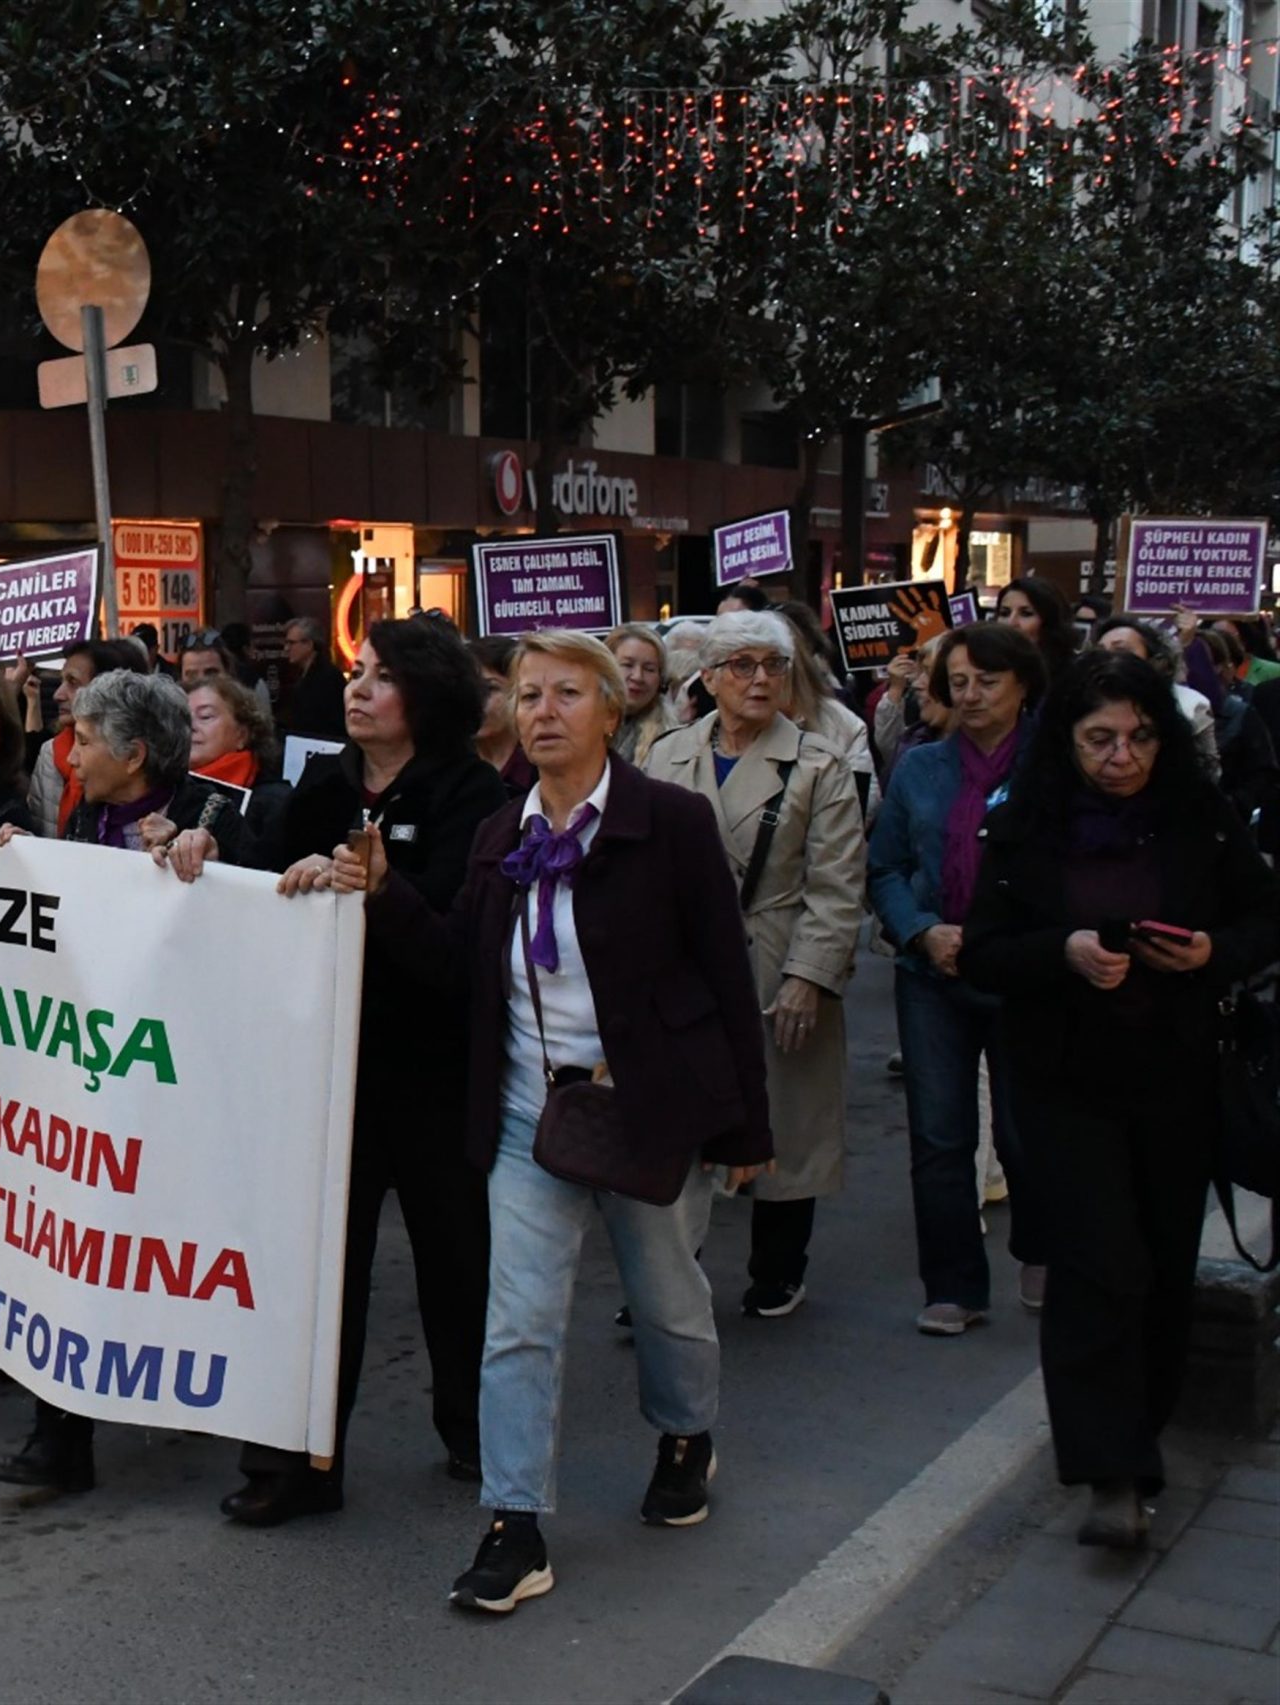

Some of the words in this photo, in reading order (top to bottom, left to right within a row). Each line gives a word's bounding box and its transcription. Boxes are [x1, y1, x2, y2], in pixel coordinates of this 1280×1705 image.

[121, 531, 141, 554] 1000
[175, 534, 192, 556] SMS
[725, 531, 742, 550] DUY
[1143, 528, 1203, 547] ŞÜPHELİ
[1207, 531, 1250, 545] KADIN
[490, 555, 521, 573] ESNEK
[523, 551, 568, 574] ÇALIŞMA
[723, 549, 749, 573] ÇIKAR
[1138, 546, 1189, 561] ÖLÜMÜ
[1193, 548, 1253, 562] YOKTUR.
[1136, 562, 1203, 578] GİZLENEN
[1207, 565, 1253, 578] ERKEK
[123, 572, 131, 606] 5
[138, 572, 156, 606] GB
[161, 573, 190, 606] 148
[512, 576, 534, 594] TAM
[1135, 579, 1189, 597] ŞİDDETİ
[1193, 582, 1250, 596] VARDIR.
[839, 602, 891, 623] KADINA
[25, 621, 81, 648] NEREDE?
